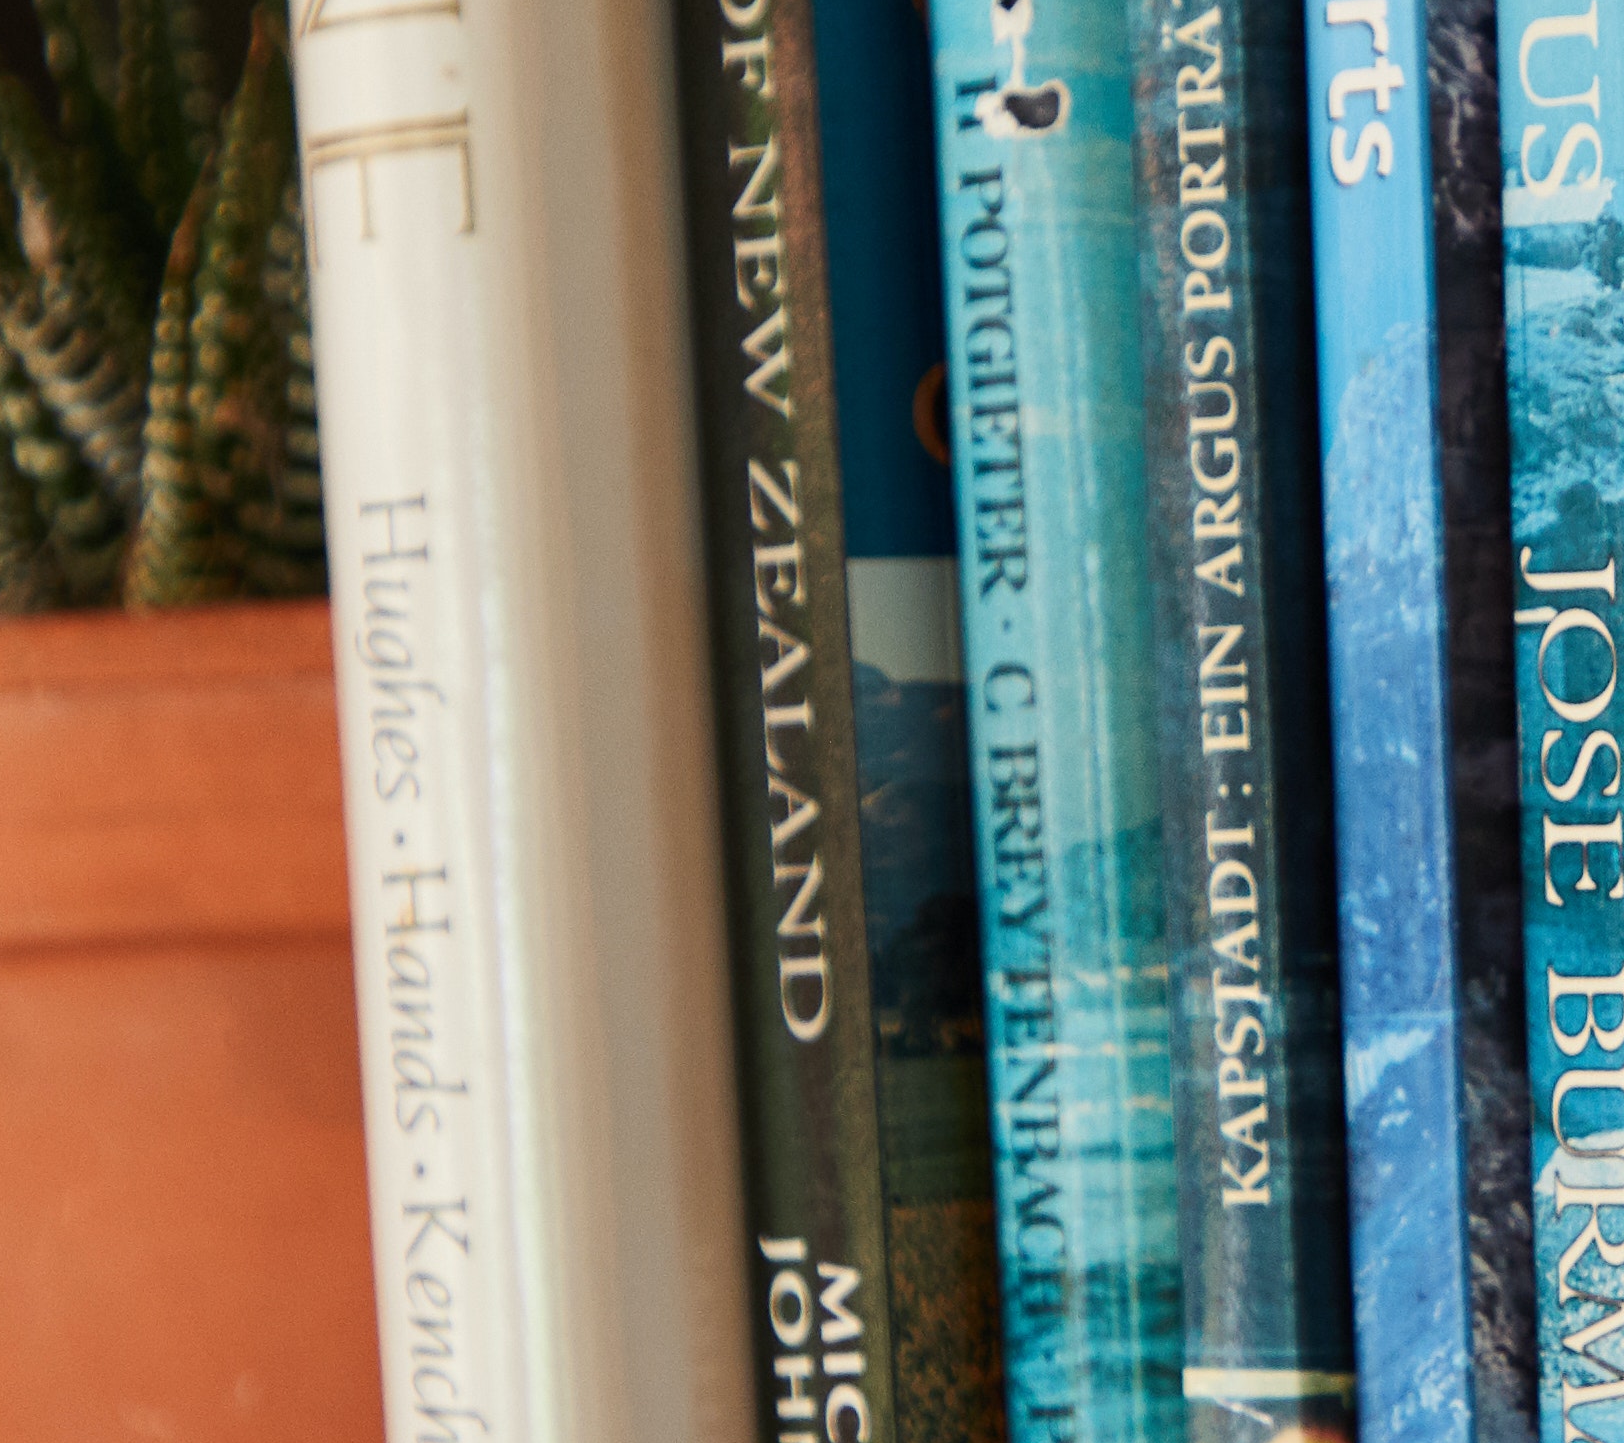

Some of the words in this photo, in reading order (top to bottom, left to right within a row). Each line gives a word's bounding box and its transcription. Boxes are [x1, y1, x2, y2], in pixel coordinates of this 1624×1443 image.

[727, 136, 795, 419] NEW
[959, 162, 1029, 598] POTGIETER
[1187, 336, 1247, 595] ARGUS
[354, 490, 446, 804] Hughes
[747, 457, 832, 1044] ZEALAND
[985, 662, 1037, 715] C
[1197, 625, 1252, 754] EIN
[379, 864, 470, 1136] Hands
[988, 746, 1070, 1318] BREYTENBACH
